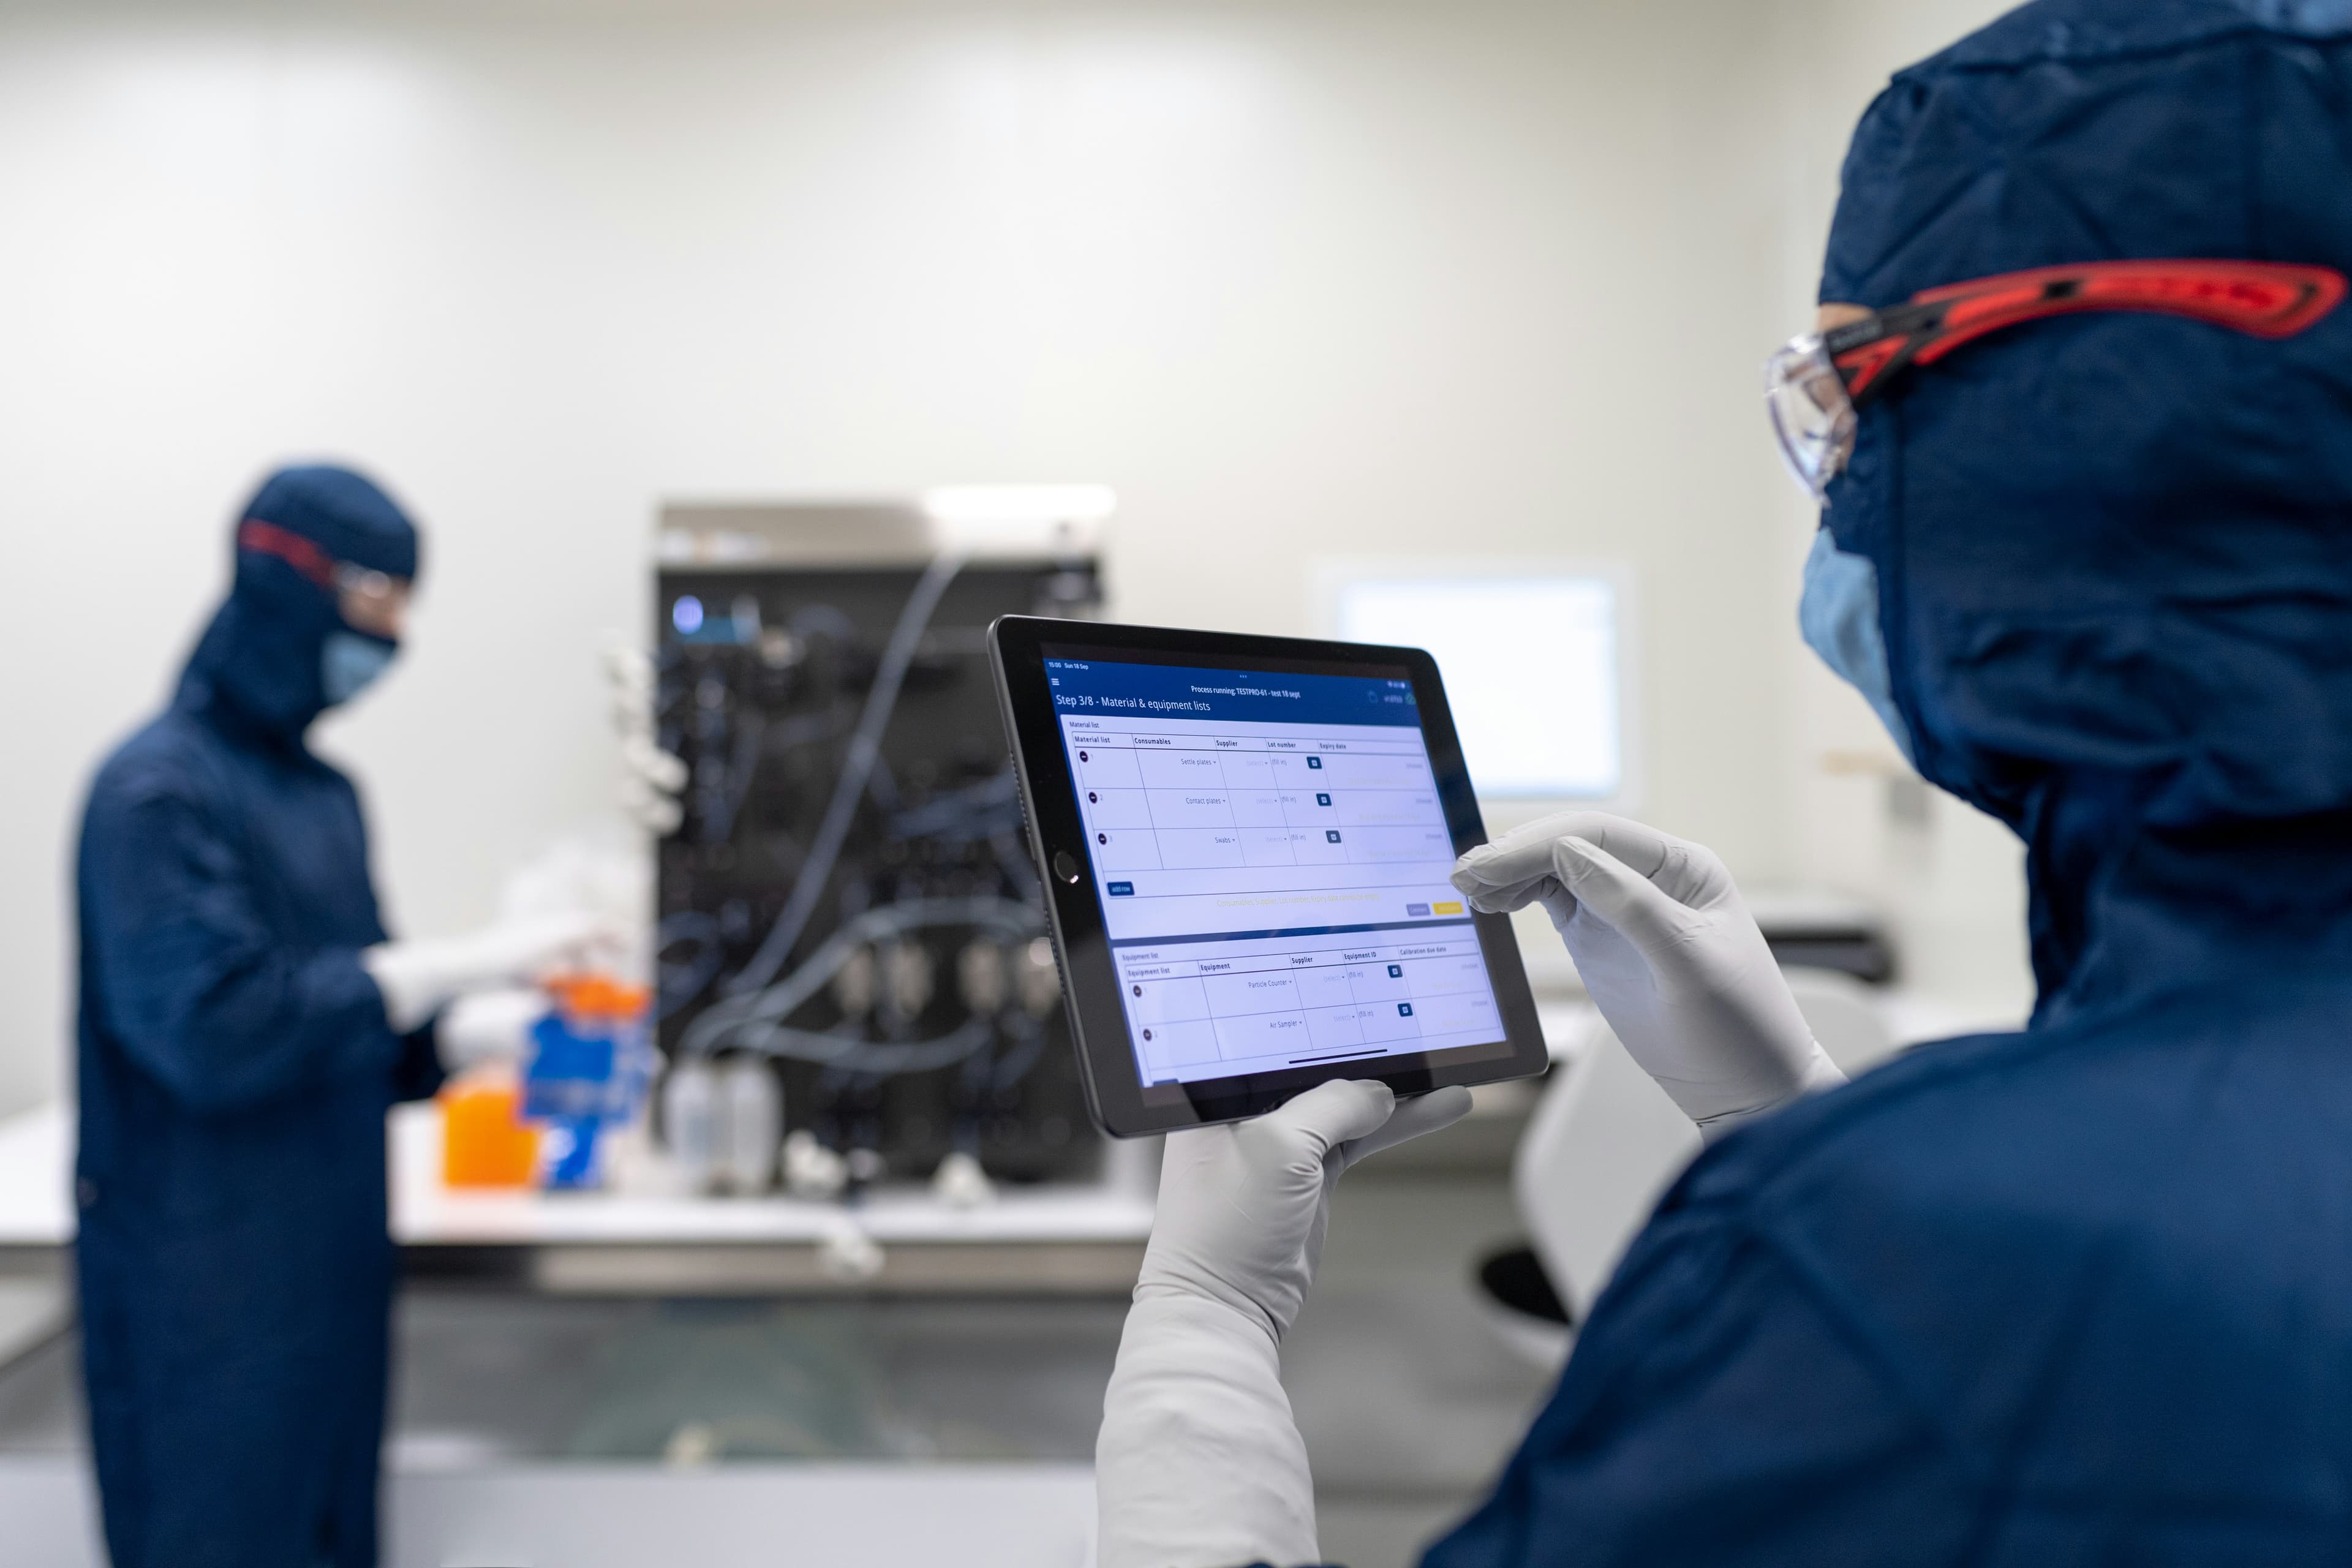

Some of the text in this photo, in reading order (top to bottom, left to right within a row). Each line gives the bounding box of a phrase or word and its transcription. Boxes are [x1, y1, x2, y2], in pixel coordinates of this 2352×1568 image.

[1235, 688, 1267, 696] TESTPRO-61
[1055, 695, 1077, 707] Step
[1079, 696, 1094, 706] 3/8
[1101, 696, 1137, 708] Material
[1139, 698, 1146, 708] &
[1148, 699, 1193, 712] equipment
[1194, 701, 1211, 711] lists
[1206, 797, 1221, 806] plates
[1122, 953, 1149, 962] Equipment
[1344, 952, 1370, 960] Equipment
[1200, 963, 1231, 971] Equipment
[1128, 968, 1159, 977] Equipment
[1278, 1020, 1297, 1029] Sampler
